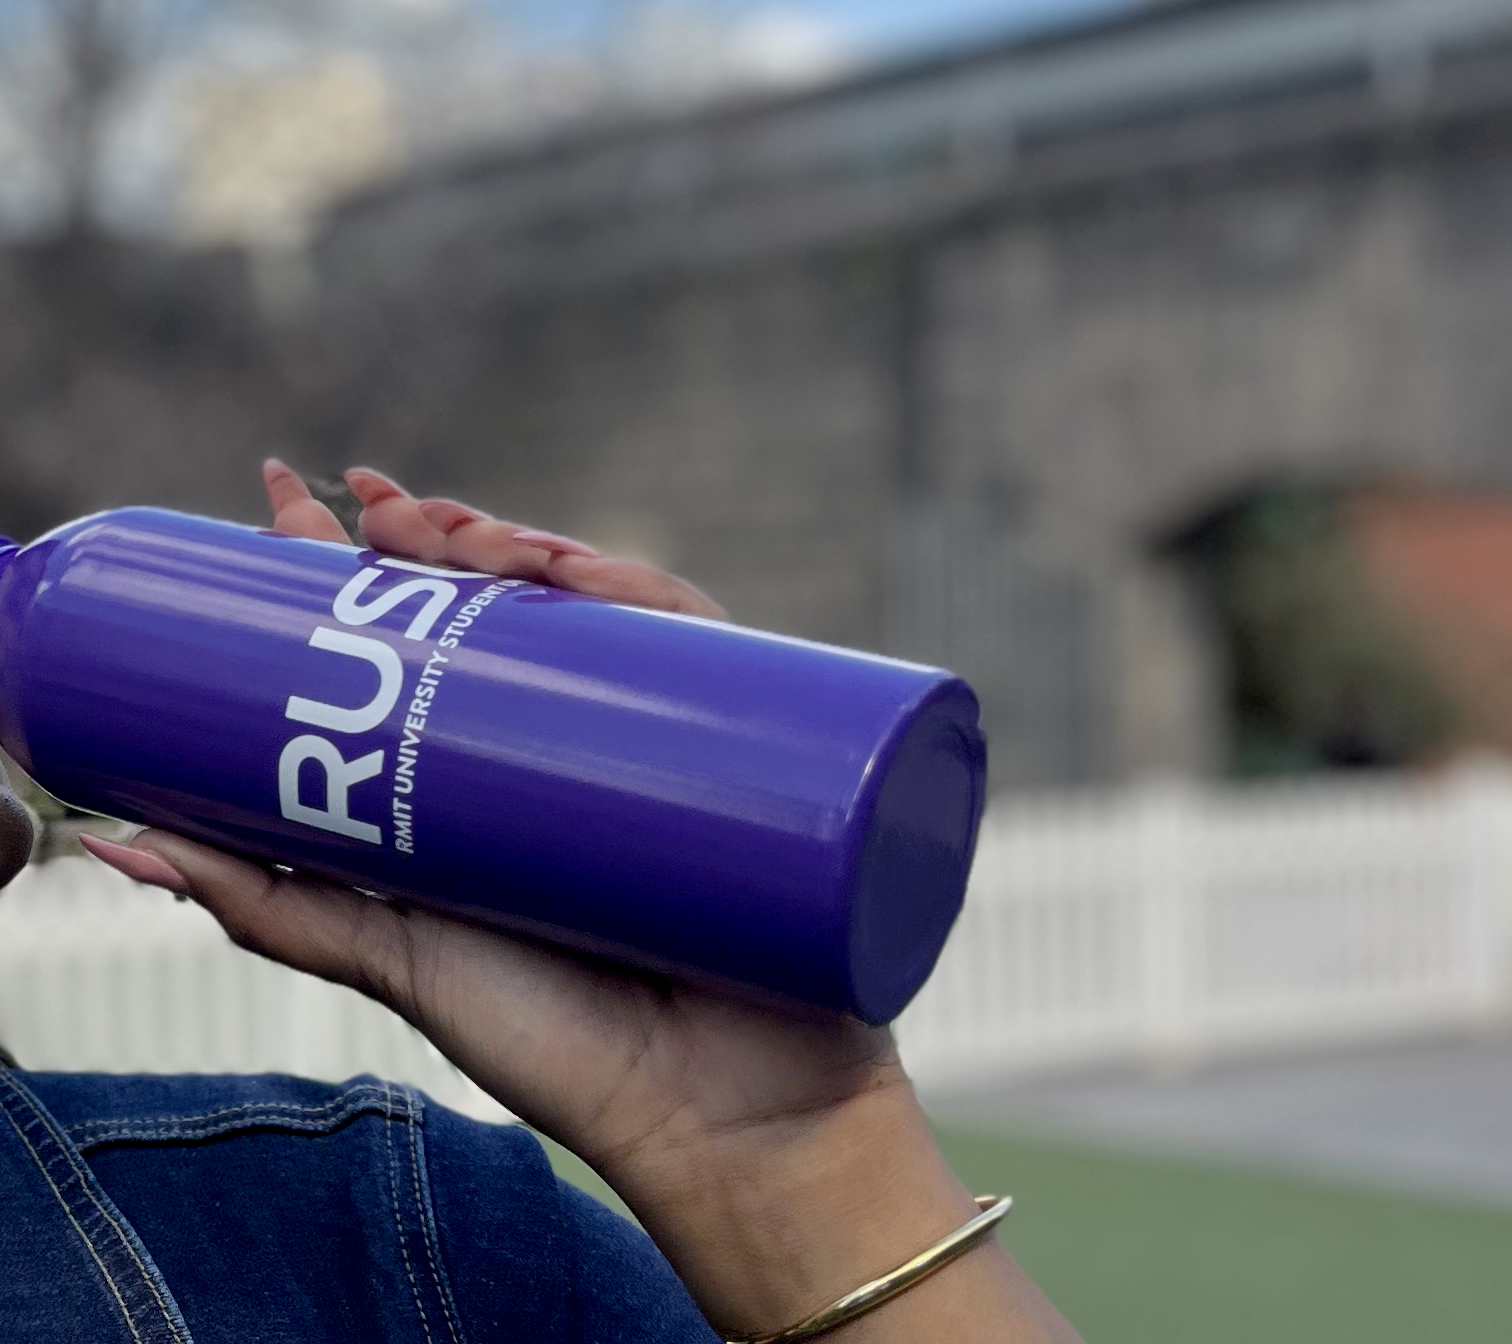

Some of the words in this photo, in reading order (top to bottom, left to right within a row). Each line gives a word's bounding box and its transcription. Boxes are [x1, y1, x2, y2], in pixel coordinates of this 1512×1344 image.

[438, 583, 508, 649] STUDENT
[393, 650, 450, 795] UNIVERSITY
[392, 797, 415, 855] RMIT
